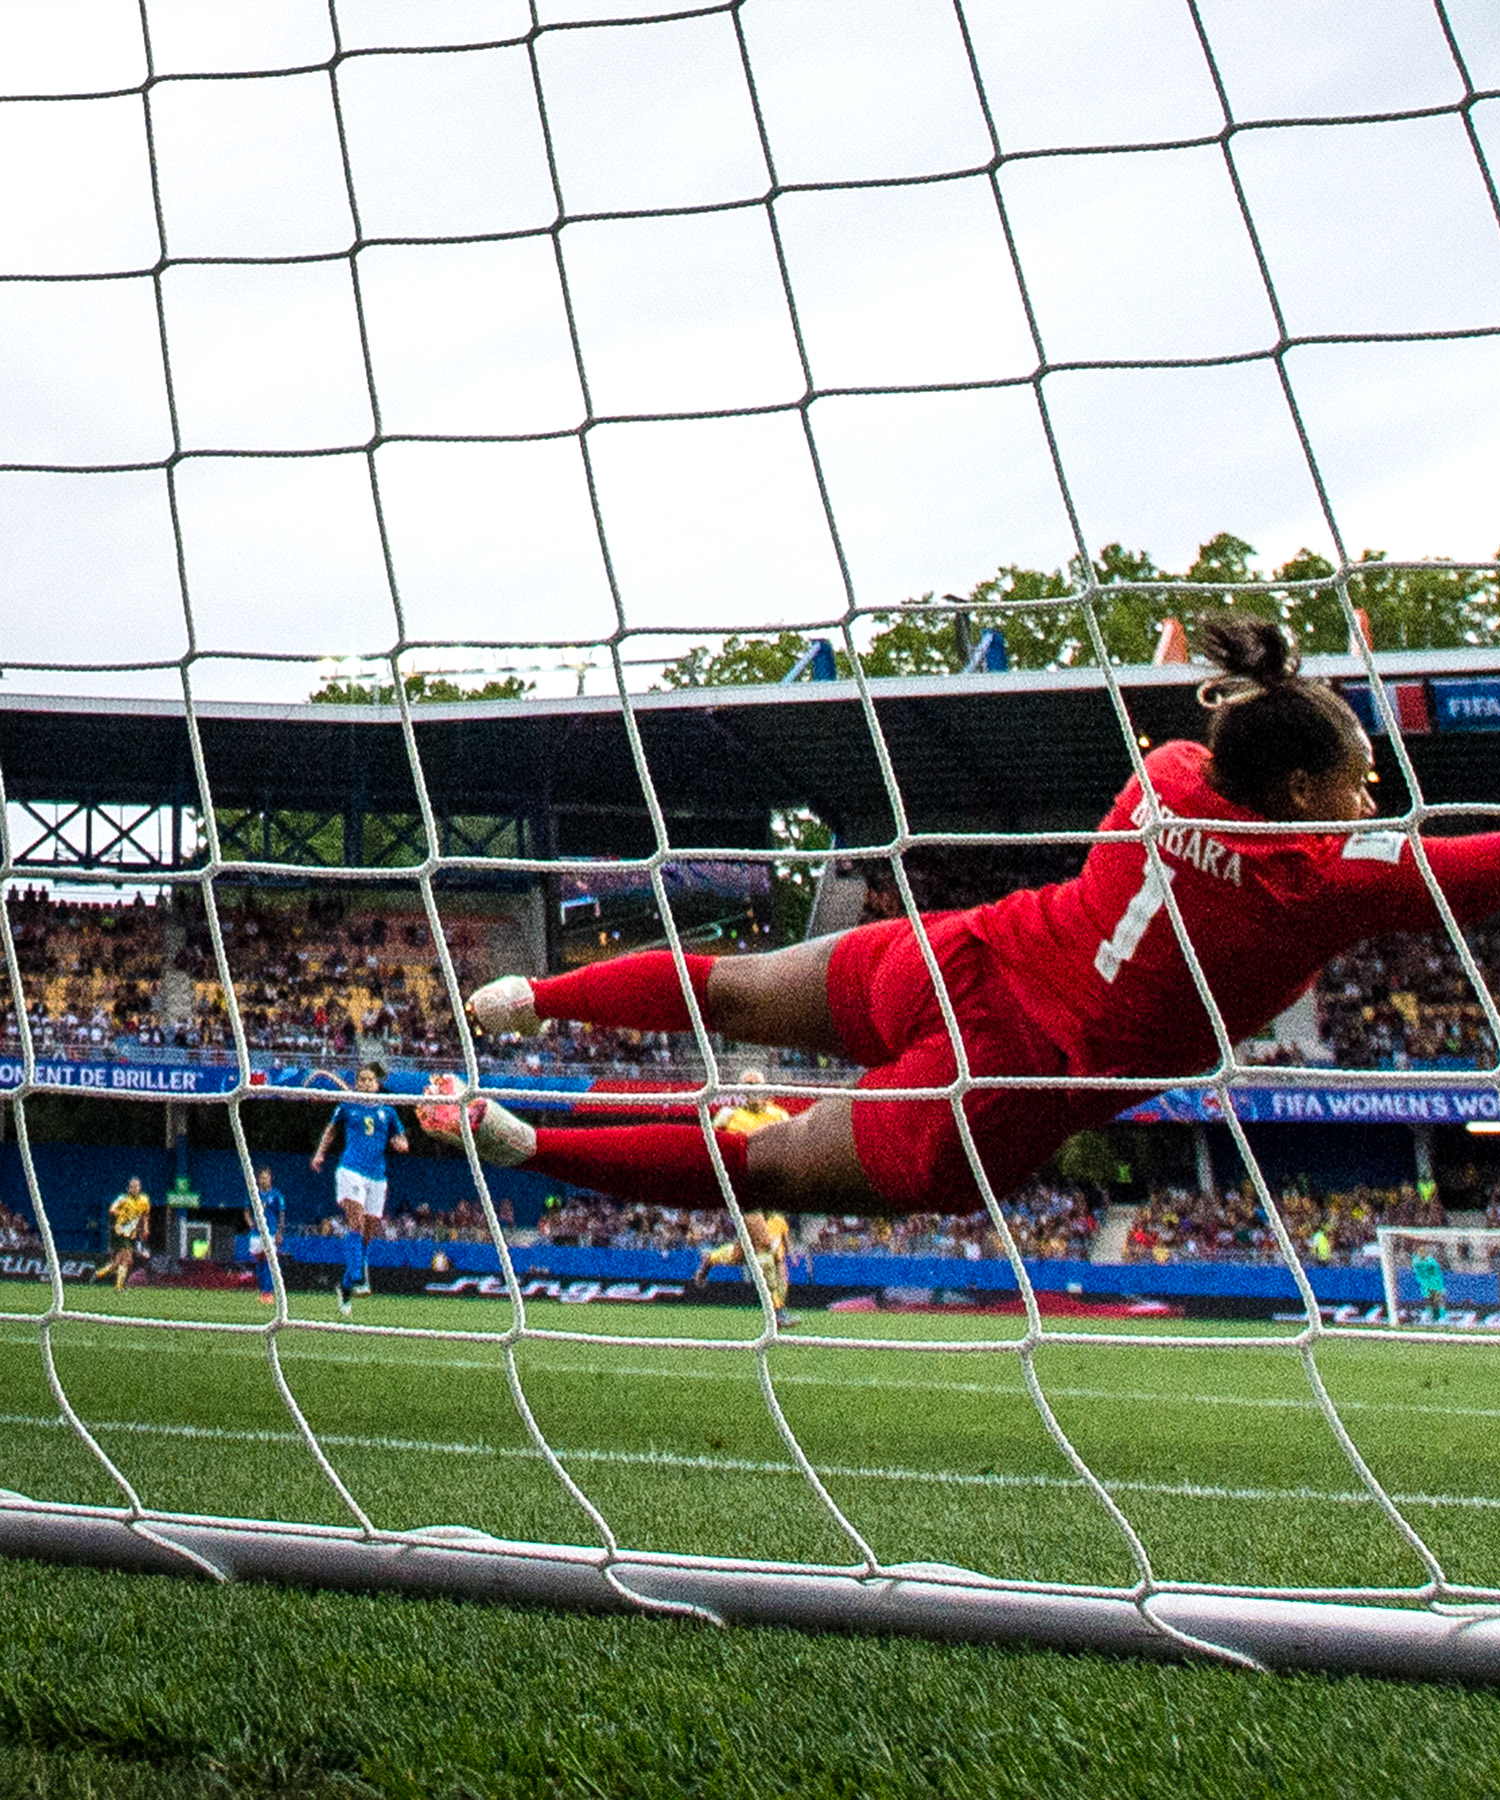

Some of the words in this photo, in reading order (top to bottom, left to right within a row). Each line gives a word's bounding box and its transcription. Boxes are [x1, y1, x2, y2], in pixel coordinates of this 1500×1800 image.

[1094, 856, 1177, 984] 1
[79, 1069, 108, 1087] DE
[112, 1068, 197, 1091] BRILLER
[1272, 1094, 1326, 1116] FIFA
[1326, 1094, 1448, 1117] WOMEN'S
